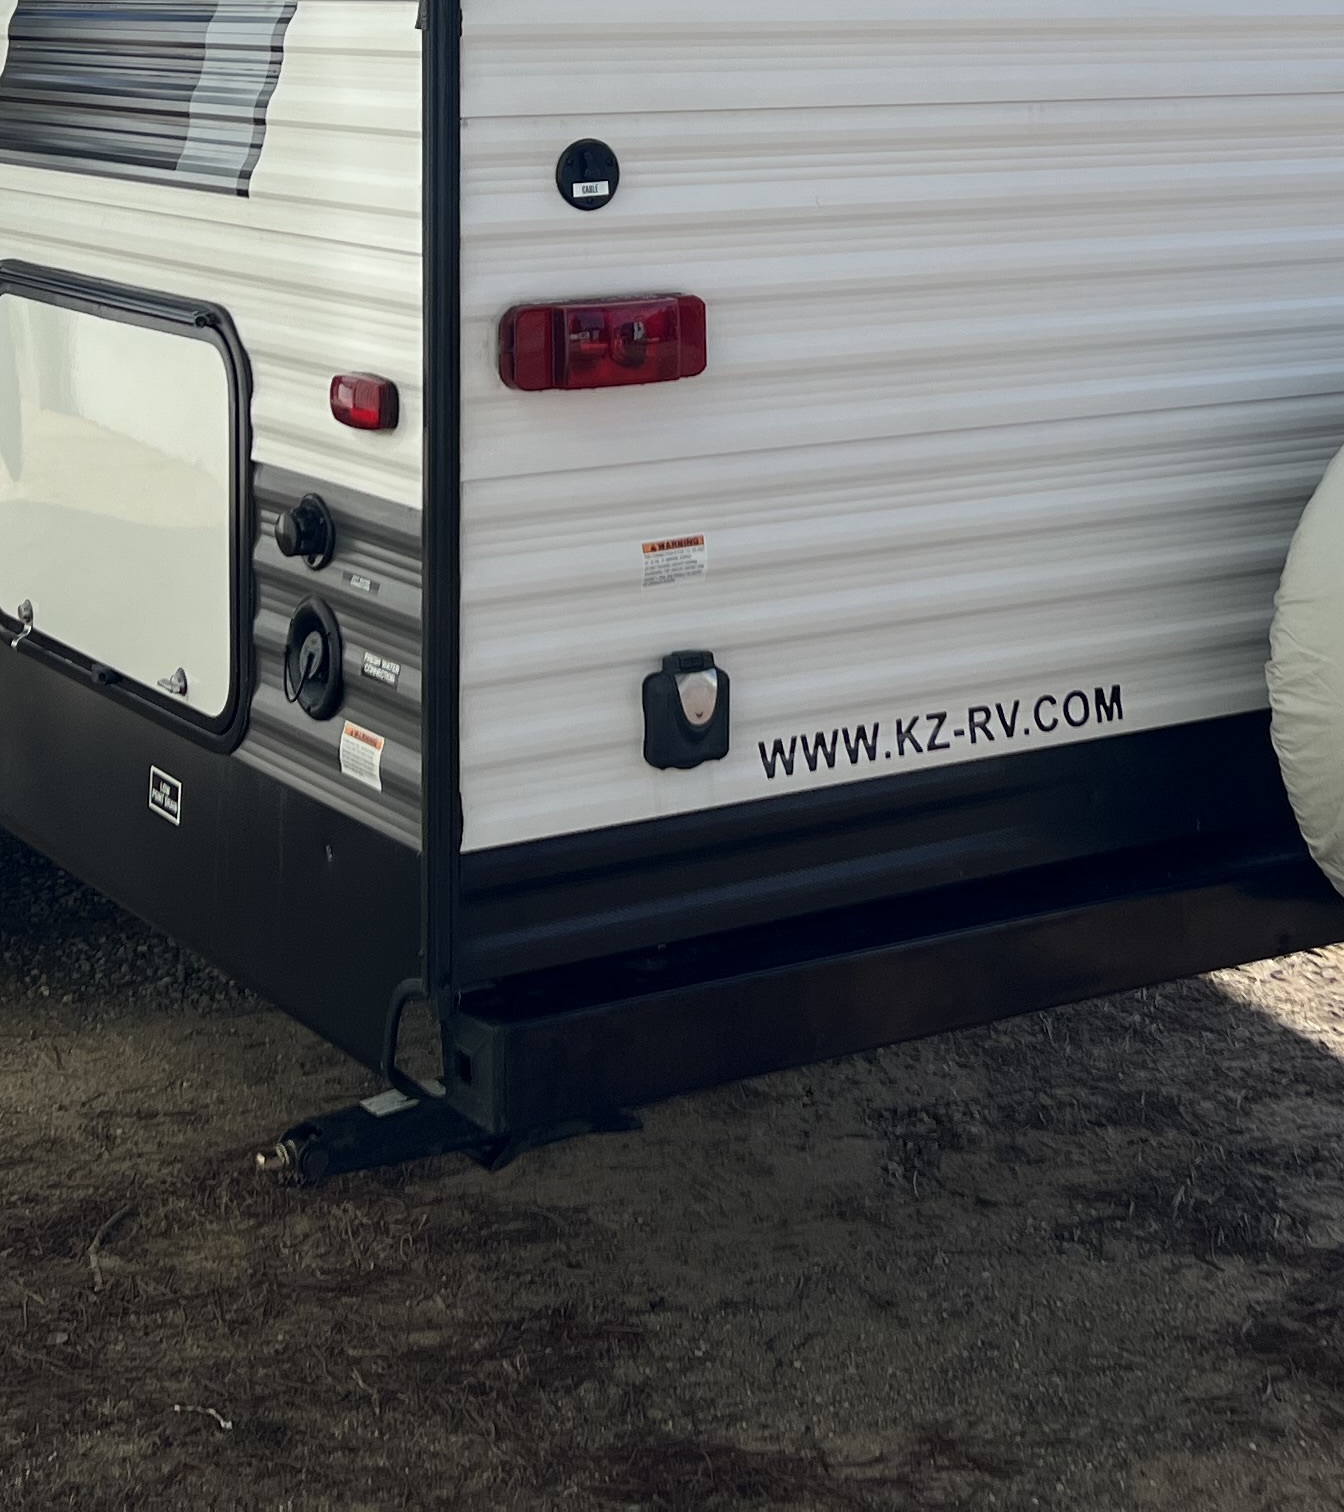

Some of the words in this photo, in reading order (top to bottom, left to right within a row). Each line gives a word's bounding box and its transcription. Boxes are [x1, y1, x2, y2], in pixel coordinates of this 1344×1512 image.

[581, 184, 599, 194] CABLE
[659, 535, 698, 551] WARNING
[382, 659, 400, 675] WATER
[758, 684, 1123, 779] WWW.KZ-RV.COM
